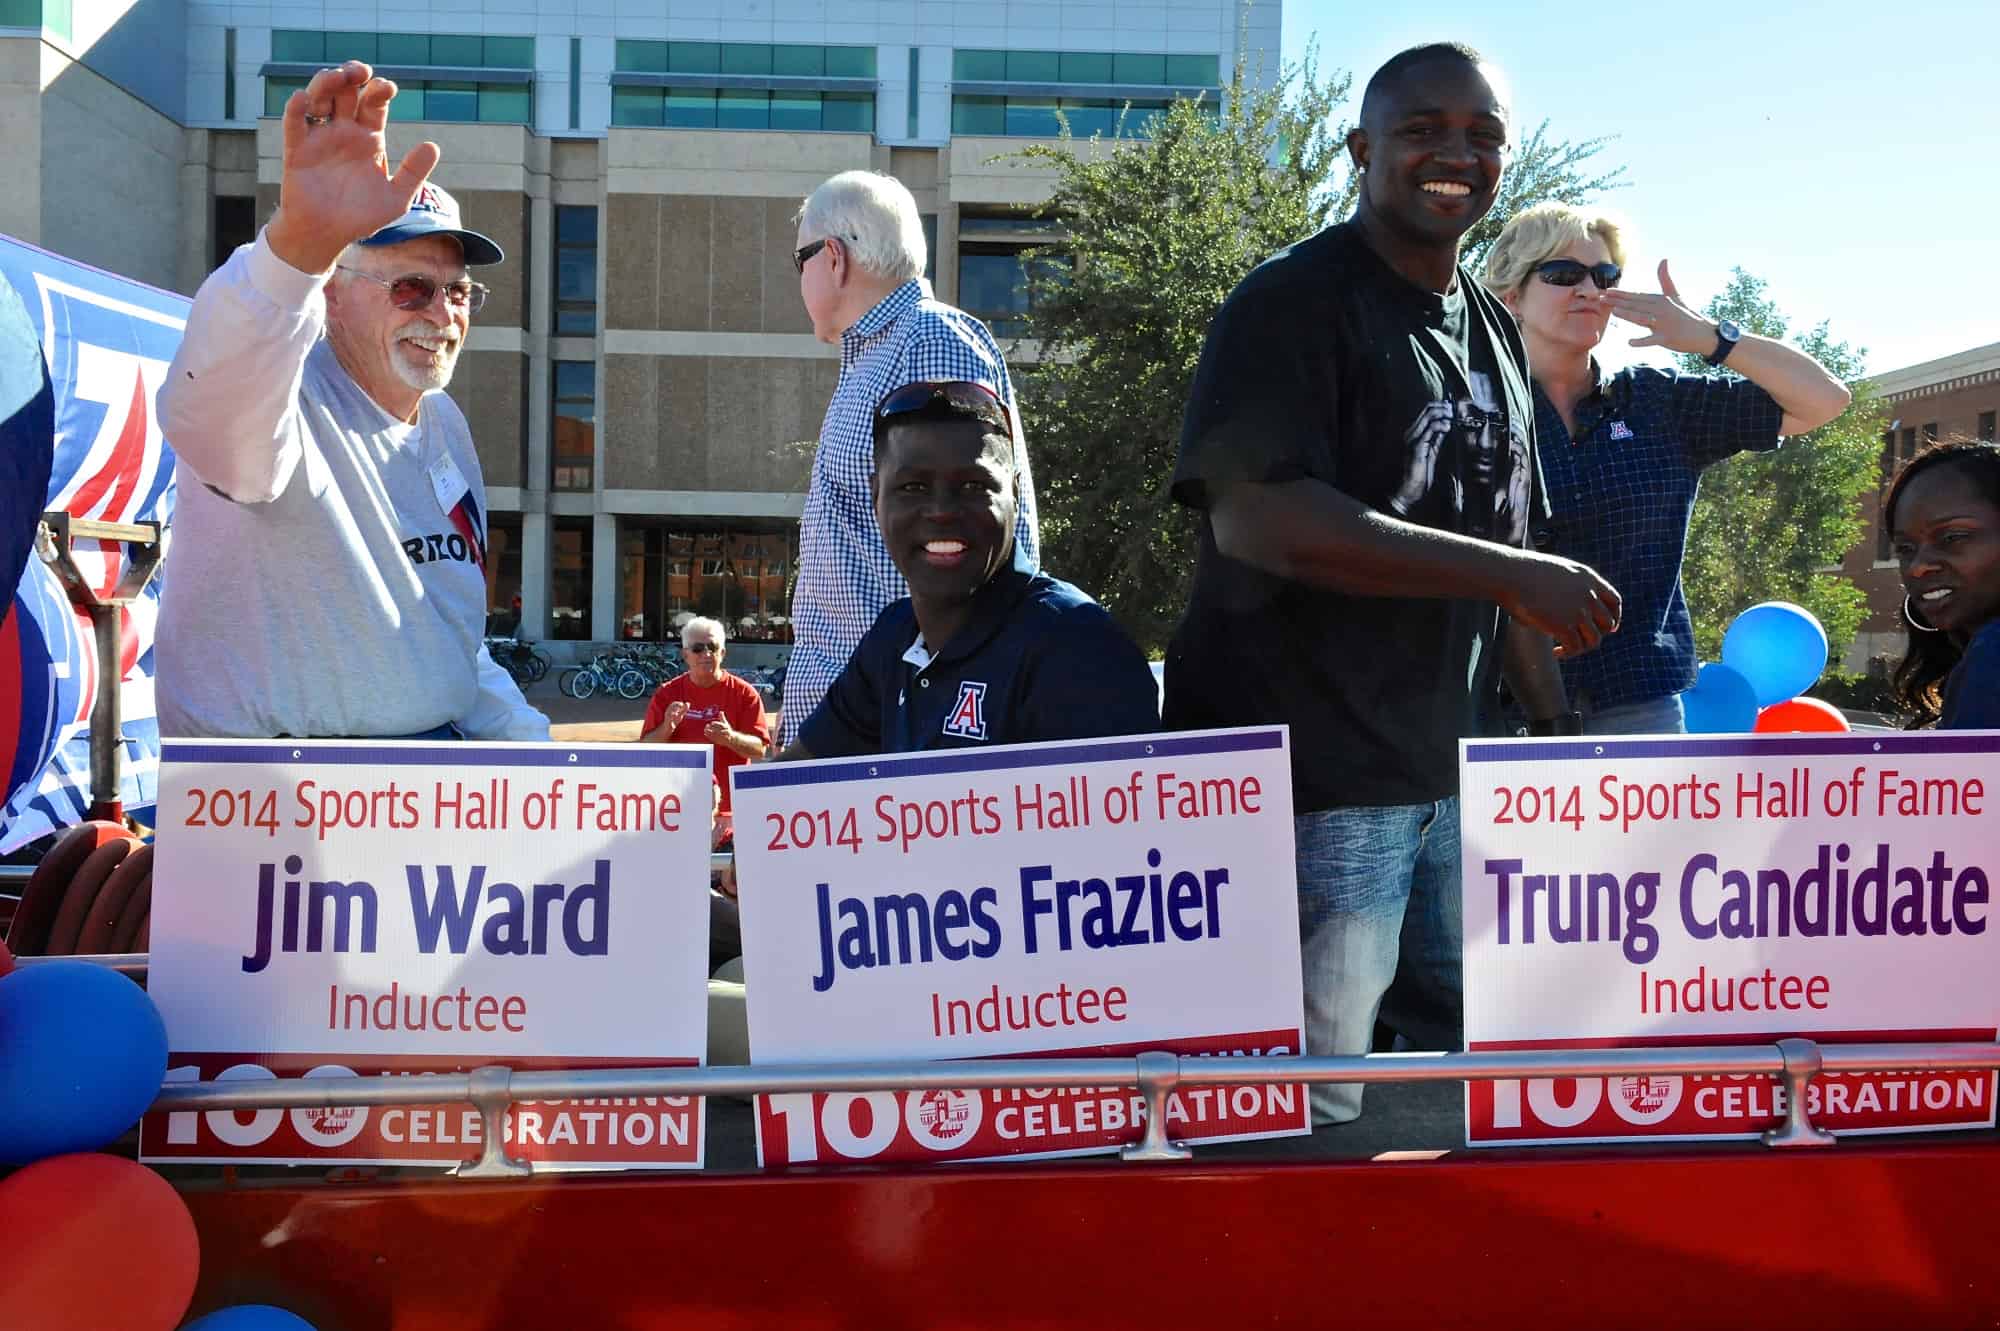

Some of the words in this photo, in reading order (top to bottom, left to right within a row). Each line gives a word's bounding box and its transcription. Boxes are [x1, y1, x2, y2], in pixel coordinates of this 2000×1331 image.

[943, 681, 987, 740] A
[185, 788, 281, 836] 2014
[294, 780, 419, 840] Sports
[434, 779, 508, 830] Hall
[523, 778, 564, 830] of
[577, 784, 682, 832] Fame
[766, 807, 863, 854] 2014
[876, 789, 1001, 853] Sports
[1015, 776, 1089, 831] Hall
[1104, 771, 1143, 824] of
[1157, 773, 1261, 820] Fame
[1493, 786, 1585, 831] 2014
[1599, 774, 1721, 833] Sports
[1736, 768, 1810, 818] Hall
[1824, 767, 1866, 817] of
[1878, 770, 1985, 817] Fame
[242, 855, 378, 973] Jim
[406, 860, 611, 957] Ward
[813, 883, 1001, 992] James
[1020, 848, 1230, 954] Frazier
[1485, 859, 1661, 965] Trung
[1680, 843, 1990, 940] Candidate
[329, 982, 526, 1033] Inductee
[932, 983, 1127, 1037] Inductee
[1641, 967, 1830, 1014] Inductee
[995, 1082, 1295, 1139] CELEBRATION
